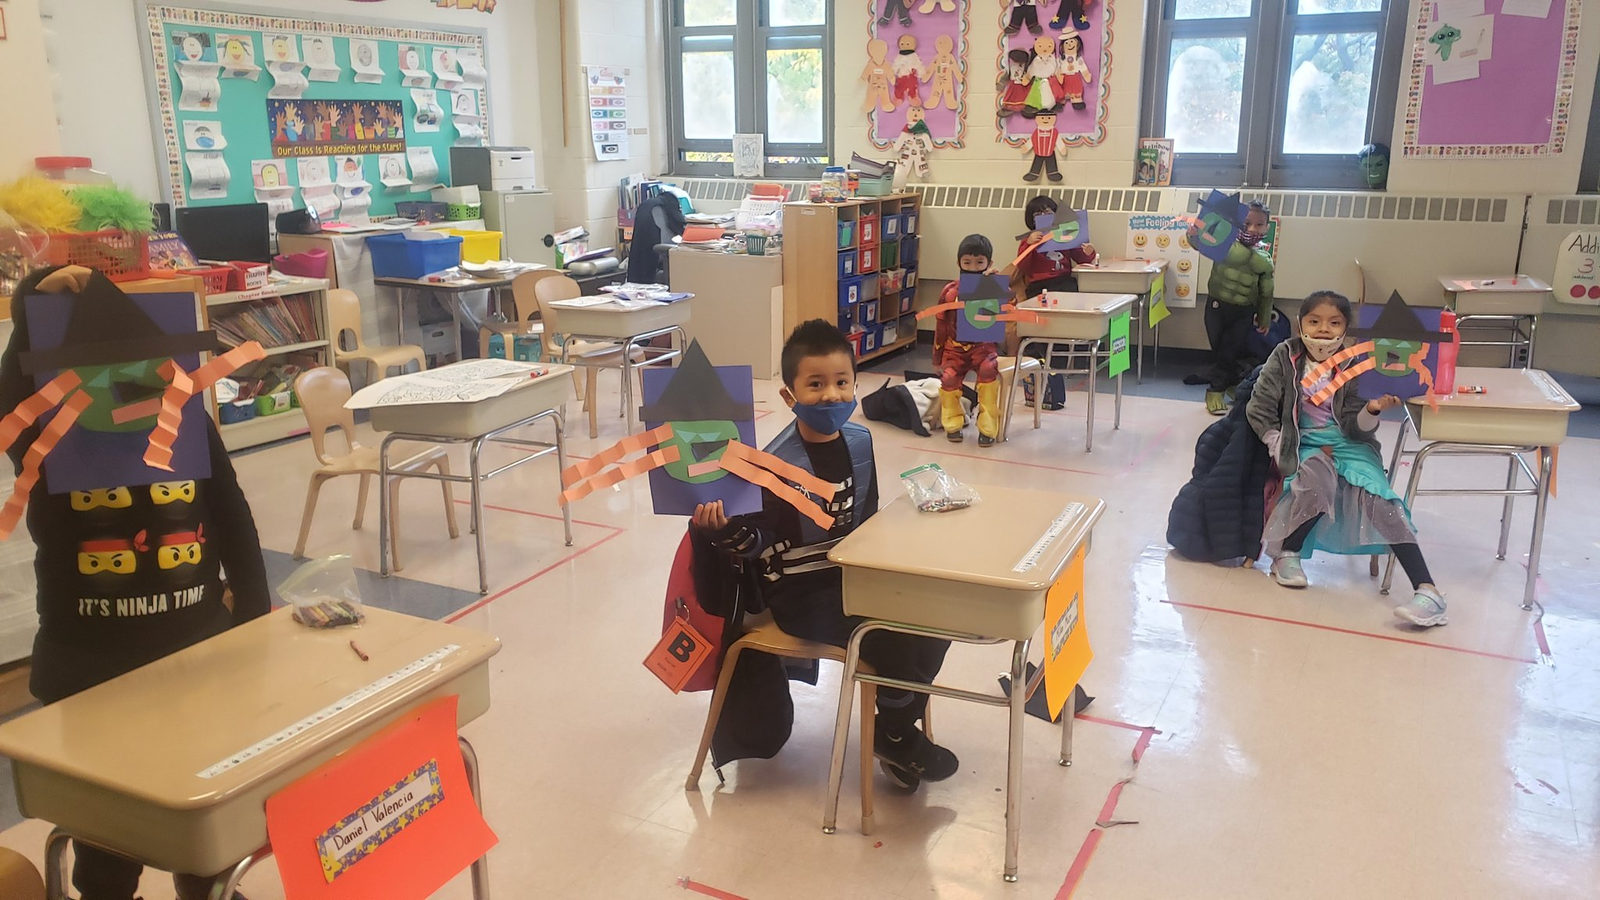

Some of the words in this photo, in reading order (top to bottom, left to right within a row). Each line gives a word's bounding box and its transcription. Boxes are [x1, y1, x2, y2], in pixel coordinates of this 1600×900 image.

[277, 146, 291, 156] Our
[294, 145, 313, 155] Class
[324, 143, 356, 154] Reaching
[358, 142, 368, 153] for
[369, 142, 381, 152] the
[382, 142, 402, 152] Stars!
[1578, 257, 1595, 274] 3
[78, 598, 111, 617] IT'S
[116, 593, 168, 617] NINJA
[667, 630, 696, 663] B
[333, 816, 369, 851] Daniel
[371, 791, 414, 823] Valencia
